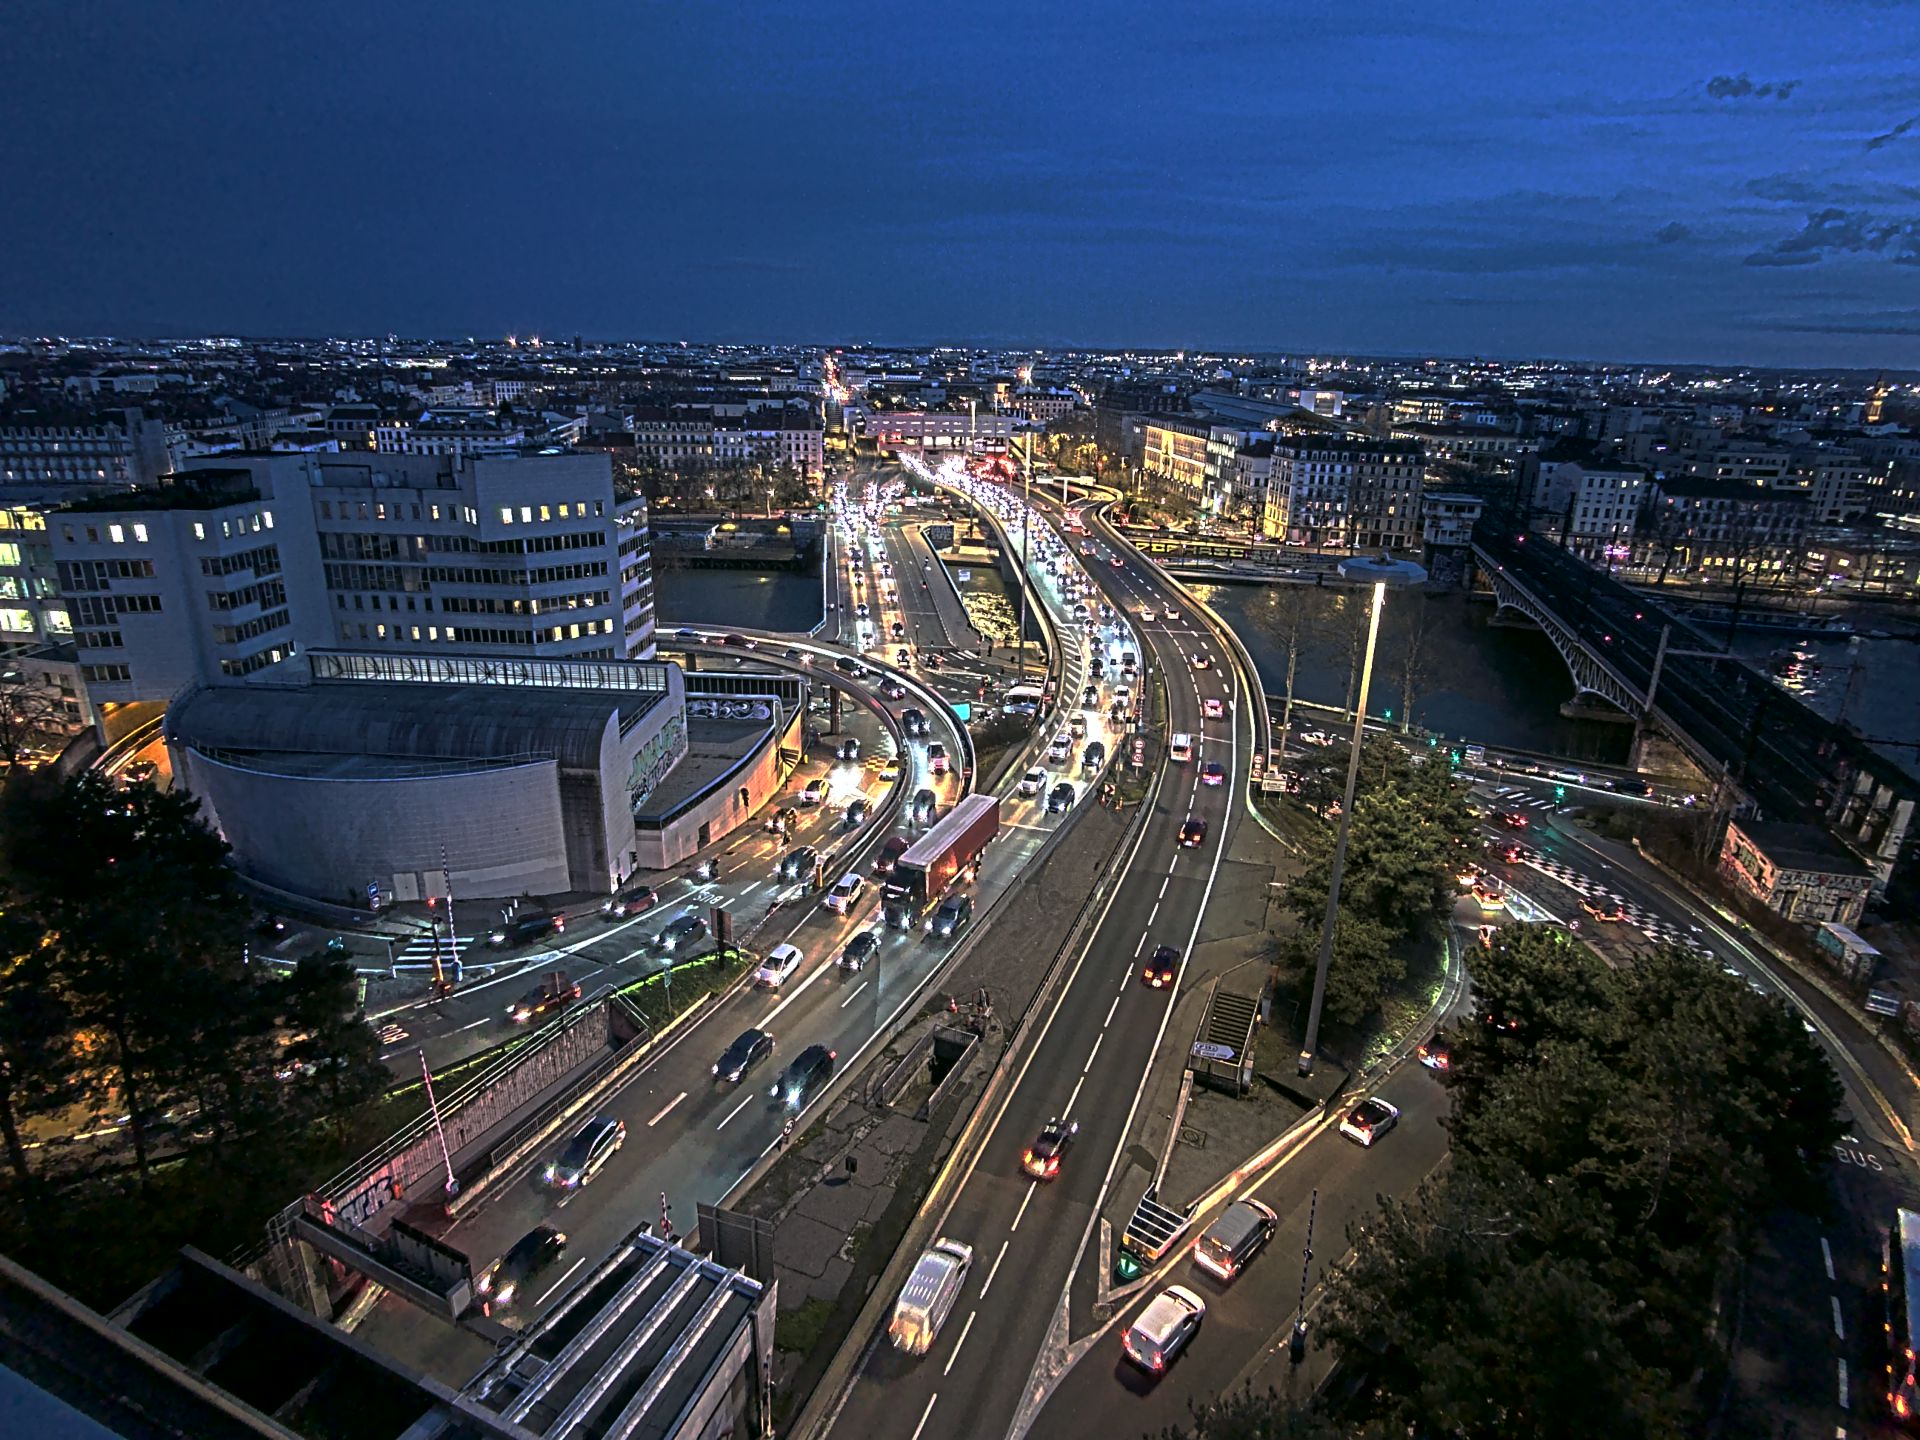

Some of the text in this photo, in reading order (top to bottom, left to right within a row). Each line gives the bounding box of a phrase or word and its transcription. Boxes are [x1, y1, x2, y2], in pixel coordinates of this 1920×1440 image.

[692, 890, 724, 904] BUS
[376, 1024, 410, 1045] BUS
[1832, 1145, 1883, 1171] BUS
